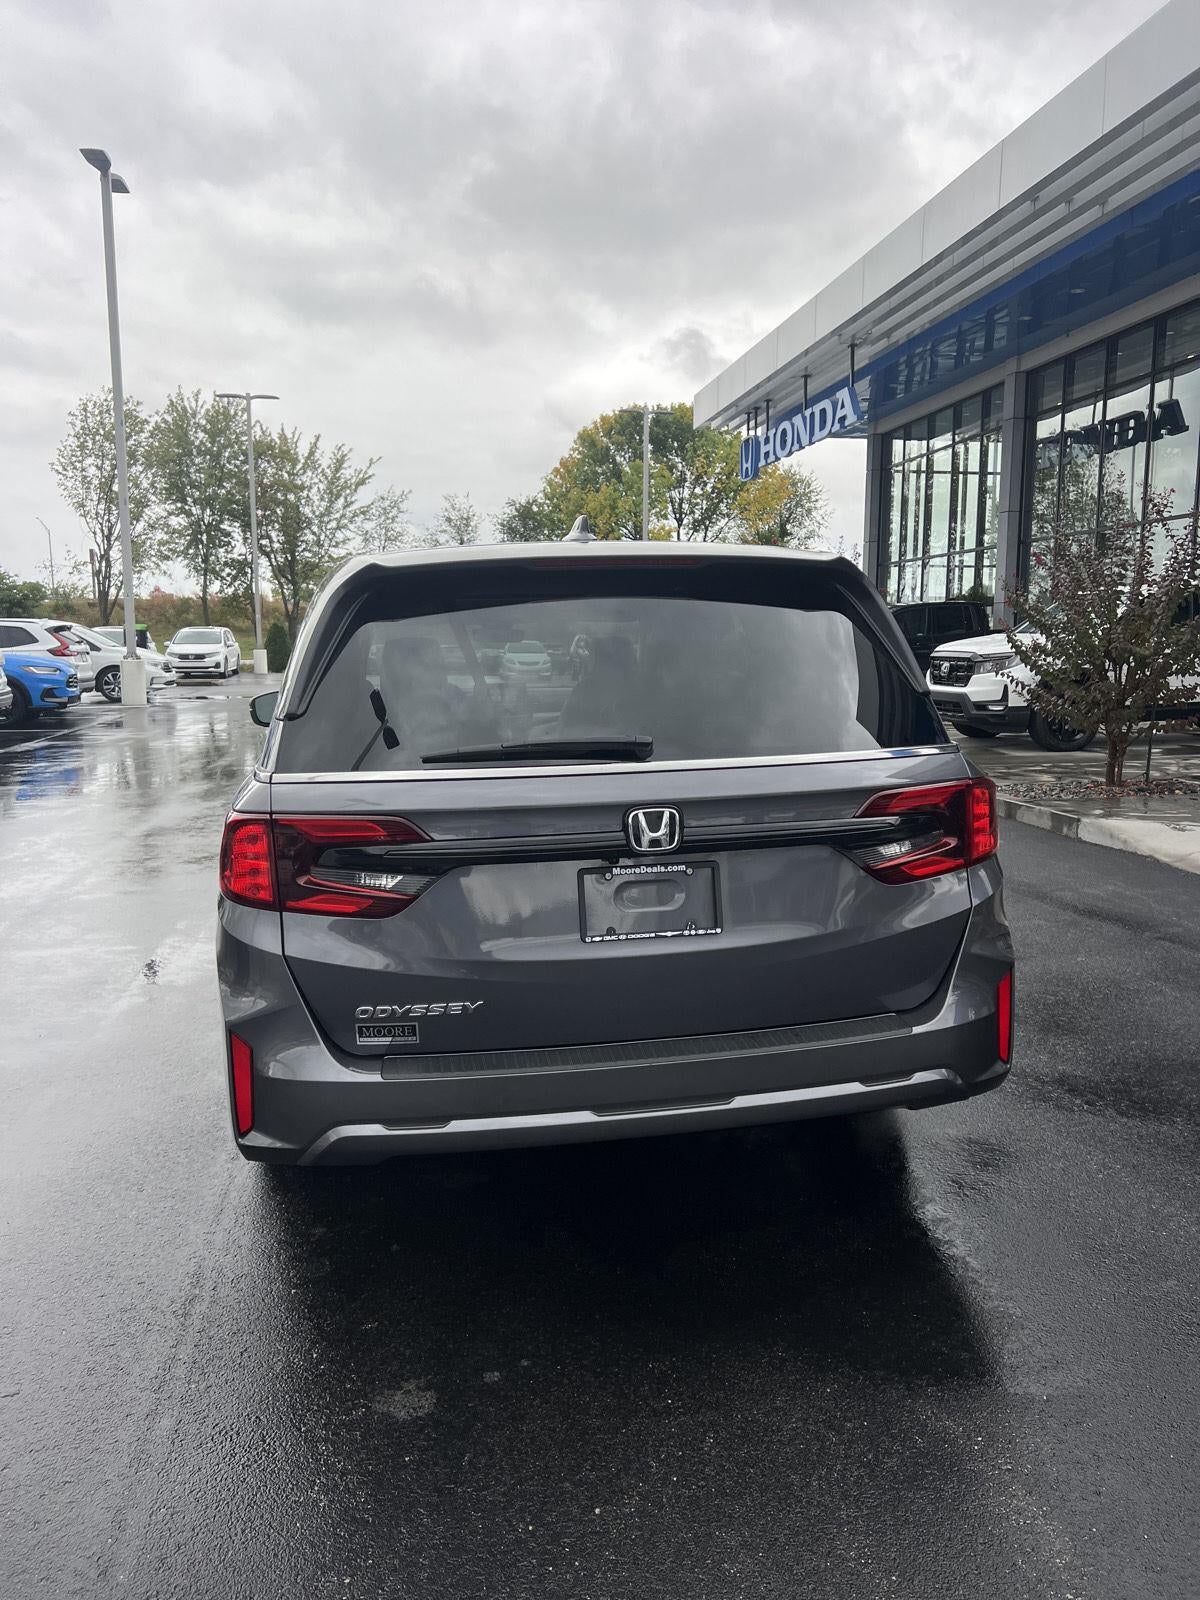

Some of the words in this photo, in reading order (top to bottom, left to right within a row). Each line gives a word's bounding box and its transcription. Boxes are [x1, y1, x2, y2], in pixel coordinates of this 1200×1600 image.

[758, 386, 858, 468] HONDA
[612, 864, 686, 875] MooreDeals.com
[355, 1001, 484, 1019] ODYSSEY
[361, 1026, 413, 1037] MOORE
